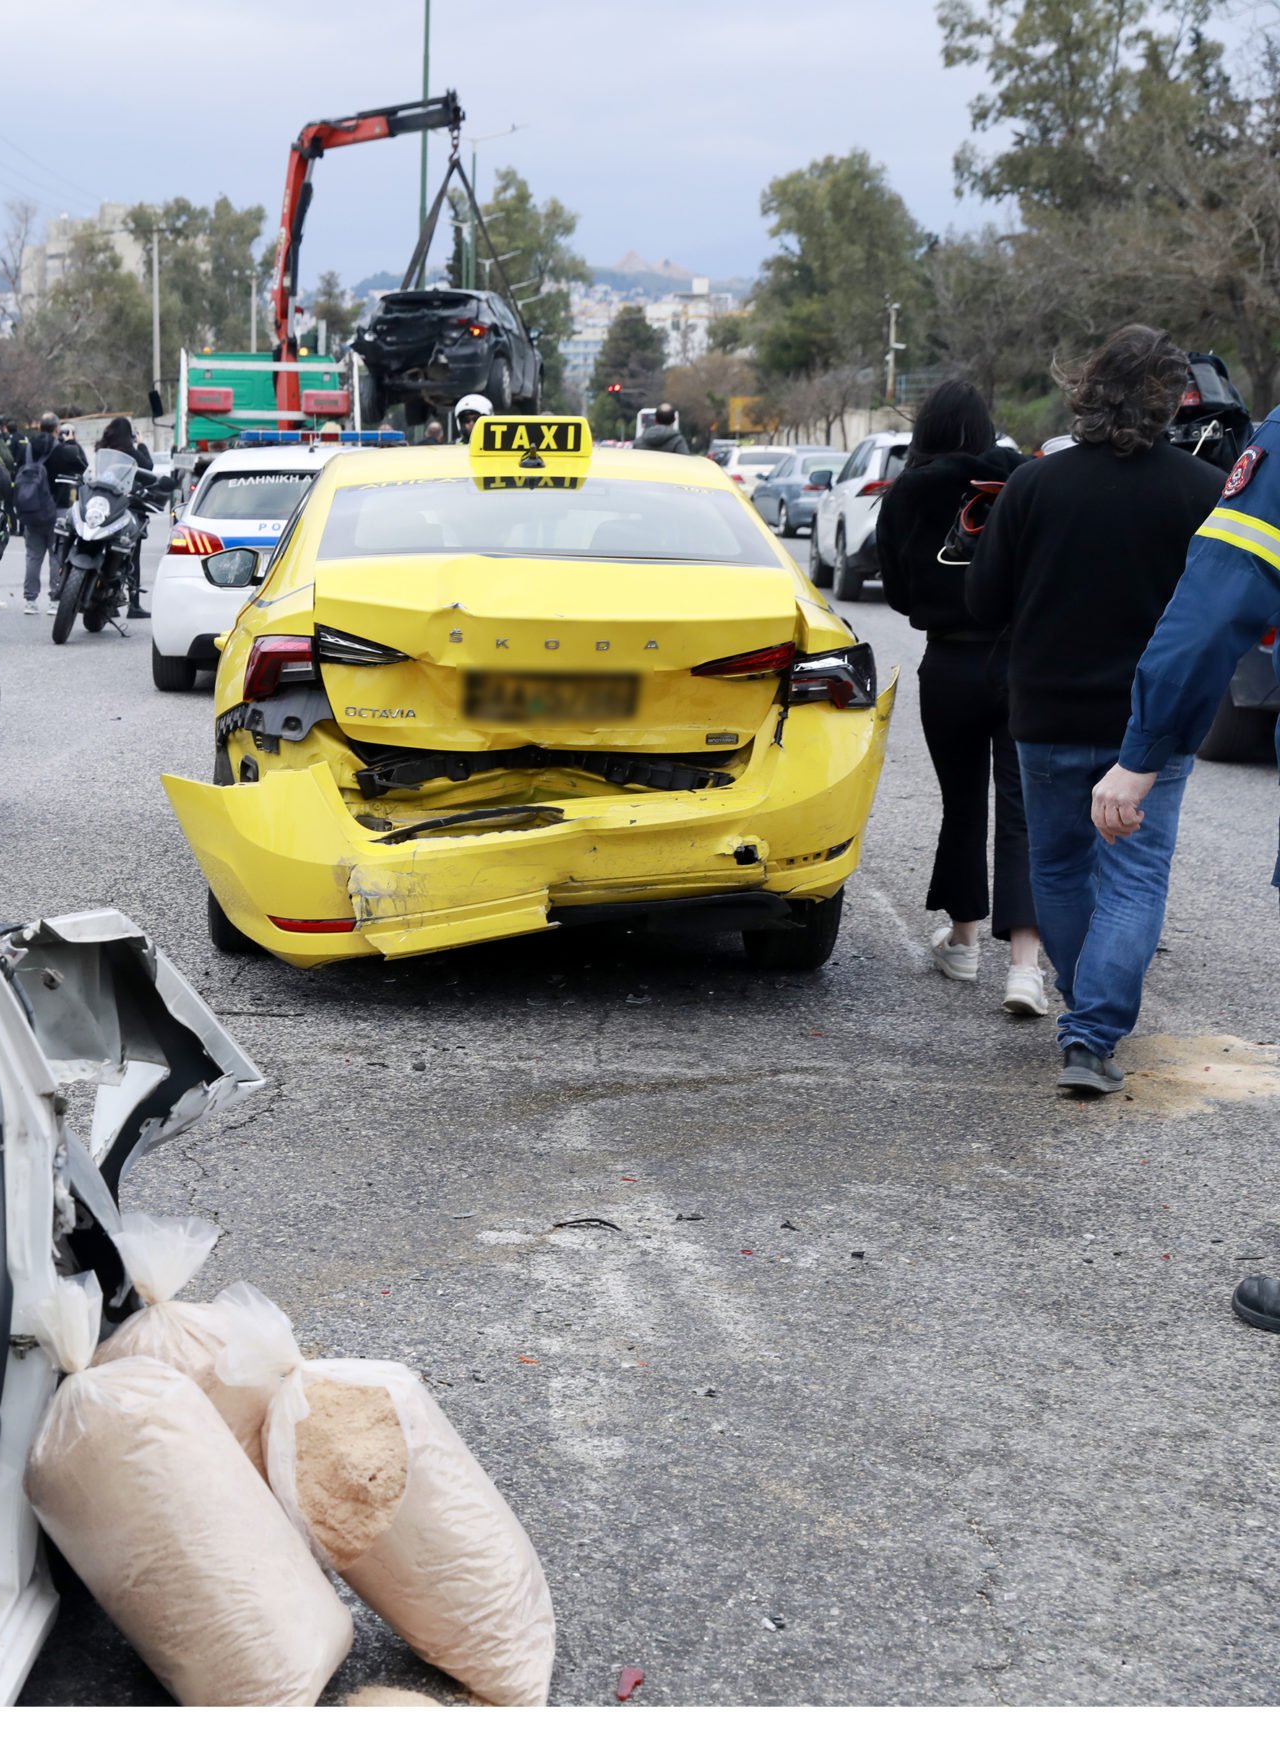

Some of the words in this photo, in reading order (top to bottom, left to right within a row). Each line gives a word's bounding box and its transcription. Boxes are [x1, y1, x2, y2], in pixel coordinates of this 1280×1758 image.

[489, 424, 576, 450] TAXI
[228, 475, 300, 489] ΕΛΛΗΝΙΚΗ
[258, 522, 282, 532] PO
[344, 706, 417, 719] OCTAVIA
